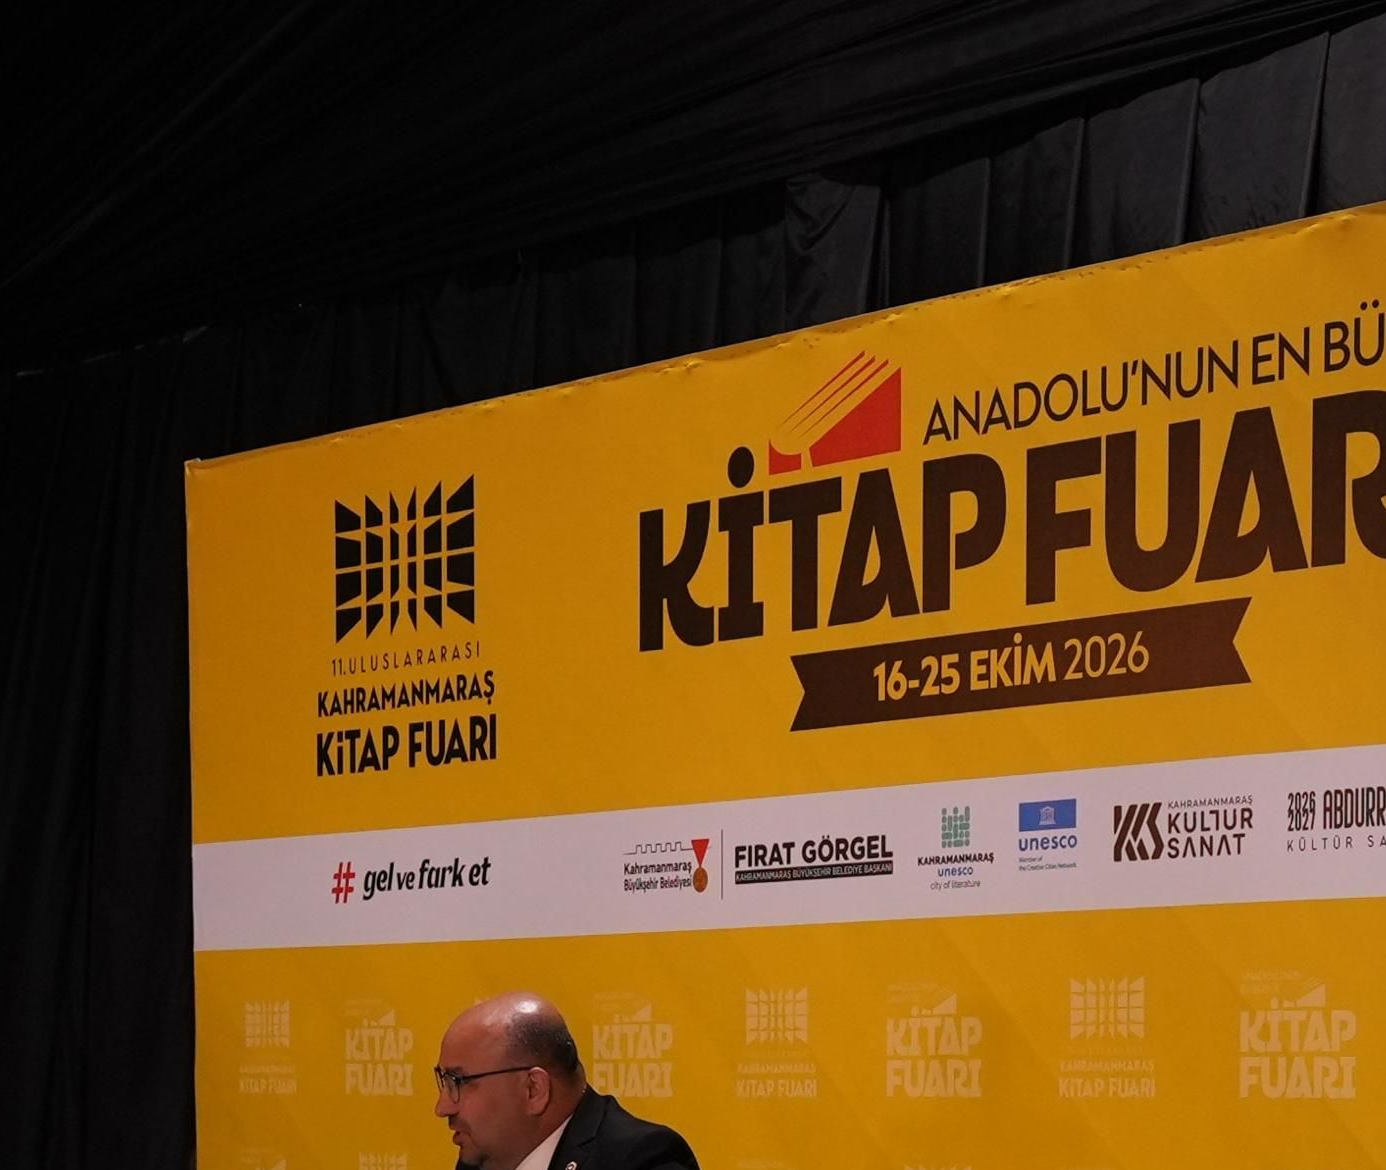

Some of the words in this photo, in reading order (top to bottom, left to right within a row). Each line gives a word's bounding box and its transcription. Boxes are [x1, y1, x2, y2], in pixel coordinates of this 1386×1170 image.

[923, 343, 1241, 446] ANADOLU'NUN
[1250, 325, 1311, 386] EN
[639, 446, 1007, 652] KİTAP
[874, 651, 960, 703] 16-25
[969, 631, 1057, 693] EKİM
[1064, 630, 1150, 681] 2026
[317, 669, 495, 718] KAHRAMANMARAŞ
[408, 713, 498, 768] FUARI
[1168, 795, 1253, 809] KAHRAMANMARAŞ
[734, 842, 795, 868] FIRAT
[801, 835, 894, 863] GÖRGEL
[918, 852, 994, 866] KAHRAMANMARAŞ
[1019, 835, 1077, 851] unesco
[1167, 833, 1246, 859] SANAT
[1287, 835, 1353, 852] KÜLTÜR
[362, 862, 395, 901] gel
[396, 873, 415, 891] ve
[417, 857, 465, 891] fark
[467, 858, 492, 886] et
[624, 861, 692, 875] Kahramanmaraş
[938, 866, 974, 877] unesco
[345, 1063, 414, 1096] FUARI
[593, 1061, 673, 1097] FUARI
[885, 1059, 982, 1097] FUARI
[1239, 1055, 1357, 1100] FUARI
